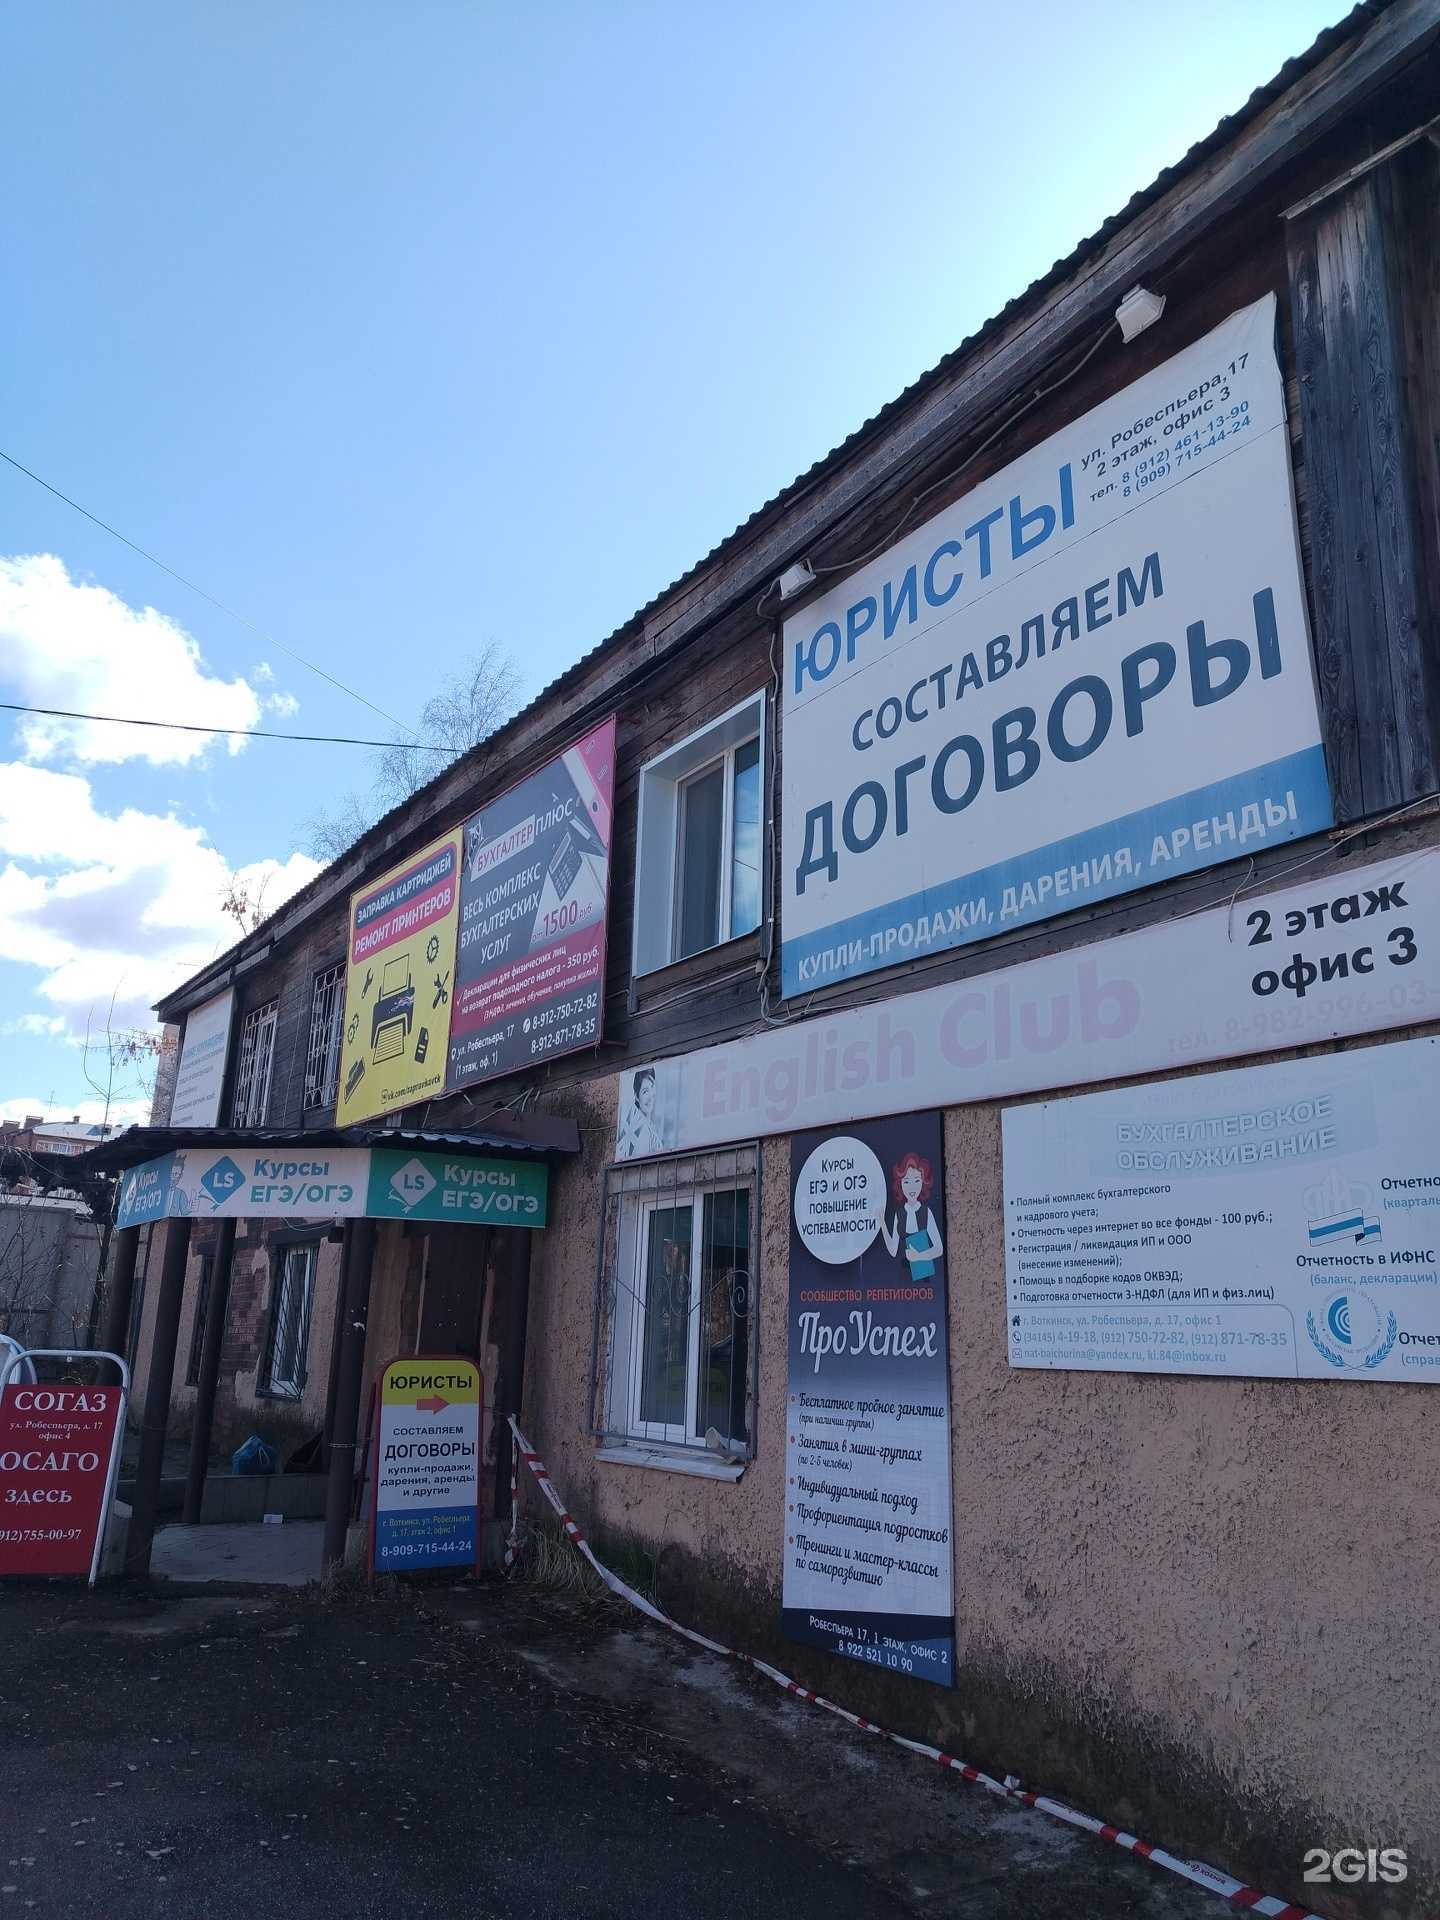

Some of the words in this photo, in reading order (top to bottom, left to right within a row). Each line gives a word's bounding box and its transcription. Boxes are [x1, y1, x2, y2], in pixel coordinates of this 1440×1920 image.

[1097, 462, 1107, 477] 2
[1111, 435, 1157, 468] этаж,
[1163, 399, 1214, 436] офис
[1219, 386, 1231, 401] 3
[1080, 449, 1106, 471] ул.
[1089, 484, 1118, 501] тел.
[1122, 472, 1130, 483] 8
[1135, 449, 1170, 477] (912)
[1174, 400, 1249, 451] 461-13-90
[1123, 486, 1131, 498] 8
[1135, 462, 1171, 492] (909)
[1175, 415, 1251, 466] 715-44-24
[794, 463, 1075, 696] ЮРИСТЫ
[852, 551, 1165, 751] СОСТАВЛЯЕМ
[796, 587, 1283, 896] ДОГОВОРЫ
[477, 823, 533, 872] БУХГАЛТЕР
[535, 798, 573, 836] ПЛЮС
[358, 891, 395, 923] ЗАПРАВКА
[396, 852, 451, 898] КАРТРИДЖЕЙ
[463, 896, 484, 922] ВЕСЬ
[485, 862, 541, 908] КОМПЛЕКС
[798, 899, 995, 981] КУПЛИ-ПРОДАЖИ,
[998, 846, 1141, 915] ДАРЕНИЯ,
[1150, 790, 1298, 865] АРЕНДЫ
[355, 922, 390, 955] РЕМОНТ
[391, 887, 451, 935] ПРИНТЕРОВ
[461, 891, 540, 949] БУХГАЛТЕРСКИХ
[544, 900, 578, 936] 1500
[1246, 909, 1272, 946] 2
[1285, 881, 1409, 937] этаж
[480, 933, 512, 964] УСЛУГ
[536, 966, 561, 984] налога
[567, 955, 582, 969] 350
[582, 945, 600, 966] руб.
[1251, 946, 1375, 998] офис
[1387, 926, 1418, 965] 3
[532, 992, 598, 1030] 8-912-750-72-82
[531, 1018, 596, 1054] 8-912-871-78-35
[702, 1011, 916, 1121] English
[939, 959, 1140, 1068] Club
[1115, 1095, 1334, 1144] БУХГАЛТЕРСКОЕ
[1116, 1124, 1338, 1170] ОБСЛУЖИВАНИЕ
[213, 1172, 234, 1188] LS
[254, 1159, 330, 1179] Курсы
[444, 1164, 517, 1187] Курсы
[404, 1174, 425, 1190] LS
[809, 1179, 828, 1195] ЕГЭ
[843, 1174, 867, 1191] ОГЭ
[250, 1183, 353, 1206] ЕГЭ/ОГЭ
[442, 1189, 539, 1213] ЕГЭ/ОГЭ
[1016, 1193, 1050, 1208] Полный
[1053, 1191, 1095, 1205] комплекс
[1097, 1184, 1171, 1201] бухгалтерского
[809, 1198, 867, 1215] ПОВЫШЕНИЕ
[1024, 1209, 1069, 1224] кадрового
[1071, 1207, 1099, 1221] учета;
[802, 1218, 877, 1236] УСПЕВАЕМОСТИ
[1017, 1226, 1065, 1239] Отчетность
[1067, 1224, 1093, 1236] через
[1095, 1220, 1138, 1234] интернет
[1141, 1220, 1153, 1230] во
[1156, 1218, 1172, 1229] все
[1175, 1214, 1213, 1230] фонды
[1222, 1212, 1242, 1225] 100
[1245, 1210, 1273, 1227] руб.;
[1018, 1240, 1072, 1256] Регистрация
[1081, 1238, 1138, 1253] ликвидация
[1141, 1235, 1156, 1247] ИП
[1158, 1237, 1165, 1246] и
[1167, 1233, 1192, 1246] ООО
[1018, 1258, 1062, 1272] (внесение
[1064, 1253, 1123, 1269] изменений);
[1296, 1254, 1374, 1267] Отчетность
[1379, 1255, 1386, 1265] в
[1390, 1249, 1436, 1265] ИФНС
[1019, 1275, 1056, 1288] Помощь
[1058, 1277, 1064, 1285] в
[1066, 1272, 1110, 1288] подборке
[1112, 1271, 1142, 1284] кодов
[1144, 1270, 1183, 1284] ОКВЭД;
[1310, 1274, 1357, 1287] (баланс,
[1359, 1271, 1438, 1286] декларации)
[800, 1289, 862, 1303] СООБЩЕСТВО
[866, 1287, 934, 1301] РЕПЕТИТОРОВ
[1020, 1291, 1070, 1304] Подготовка
[1072, 1291, 1123, 1302] отчетности
[1167, 1287, 1191, 1301] (для
[1194, 1288, 1209, 1300] ИП
[1213, 1290, 1219, 1299] и
[1222, 1286, 1275, 1302] физ.лиц)
[1184, 1315, 1213, 1329] офис
[1101, 1332, 1126, 1345] (912)
[1127, 1331, 1188, 1346] 750-72-82,
[1191, 1332, 1219, 1347] (912)
[1220, 1331, 1288, 1347] 871-78-35
[390, 1375, 472, 1390] ЮРИСТЫ
[15, 1391, 107, 1412] СОГАЗ
[799, 1392, 854, 1412] Бесплатное
[856, 1399, 895, 1419] пробное
[896, 1403, 945, 1421] занятие
[9, 1422, 23, 1431] ул.
[26, 1420, 81, 1431] Робеспьера,
[94, 1421, 103, 1430] 17
[393, 1426, 464, 1436] СОСТАВЛЯЕМ
[798, 1414, 813, 1430] (при
[815, 1416, 845, 1427] наличии
[845, 1417, 875, 1432] группы)
[38, 1432, 64, 1442] офис
[65, 1432, 71, 1440] 4
[385, 1442, 475, 1461] ДОГОВОРЫ
[798, 1434, 839, 1451] Занятия
[841, 1439, 848, 1453] в
[849, 1443, 922, 1465] мини-группах
[0, 1451, 99, 1472] ОСАГО
[388, 1463, 474, 1475] купли-продажи,
[810, 1454, 821, 1467] 2-5
[822, 1458, 853, 1472] человек)
[381, 1476, 431, 1487] дарения,
[434, 1474, 475, 1485] аренды
[403, 1489, 410, 1497] и
[412, 1487, 450, 1497] другие
[5, 1488, 73, 1506] здесь
[798, 1475, 879, 1502] Индивидуальный
[881, 1493, 918, 1514] подход
[797, 1503, 882, 1533] Профориентация
[884, 1523, 948, 1543] подростков
[382, 1540, 472, 1557] 8-909-715-44-24
[796, 1534, 843, 1557] Тренинги
[844, 1548, 851, 1559] и
[852, 1550, 940, 1578] мастер-классы
[795, 1557, 807, 1569] по
[808, 1559, 883, 1586] саморазвитию
[809, 1615, 854, 1638] РОБЕСПЬЕРА
[857, 1628, 870, 1644] 17,
[874, 1632, 879, 1644] 1
[882, 1637, 907, 1654] ЭТАЖ,
[911, 1644, 938, 1661] ОФИС
[941, 1652, 948, 1664] 2
[838, 1640, 844, 1651] 8
[847, 1642, 863, 1657] 922
[866, 1647, 882, 1663] 521
[886, 1653, 898, 1667] 10
[901, 1656, 913, 1672] 90
